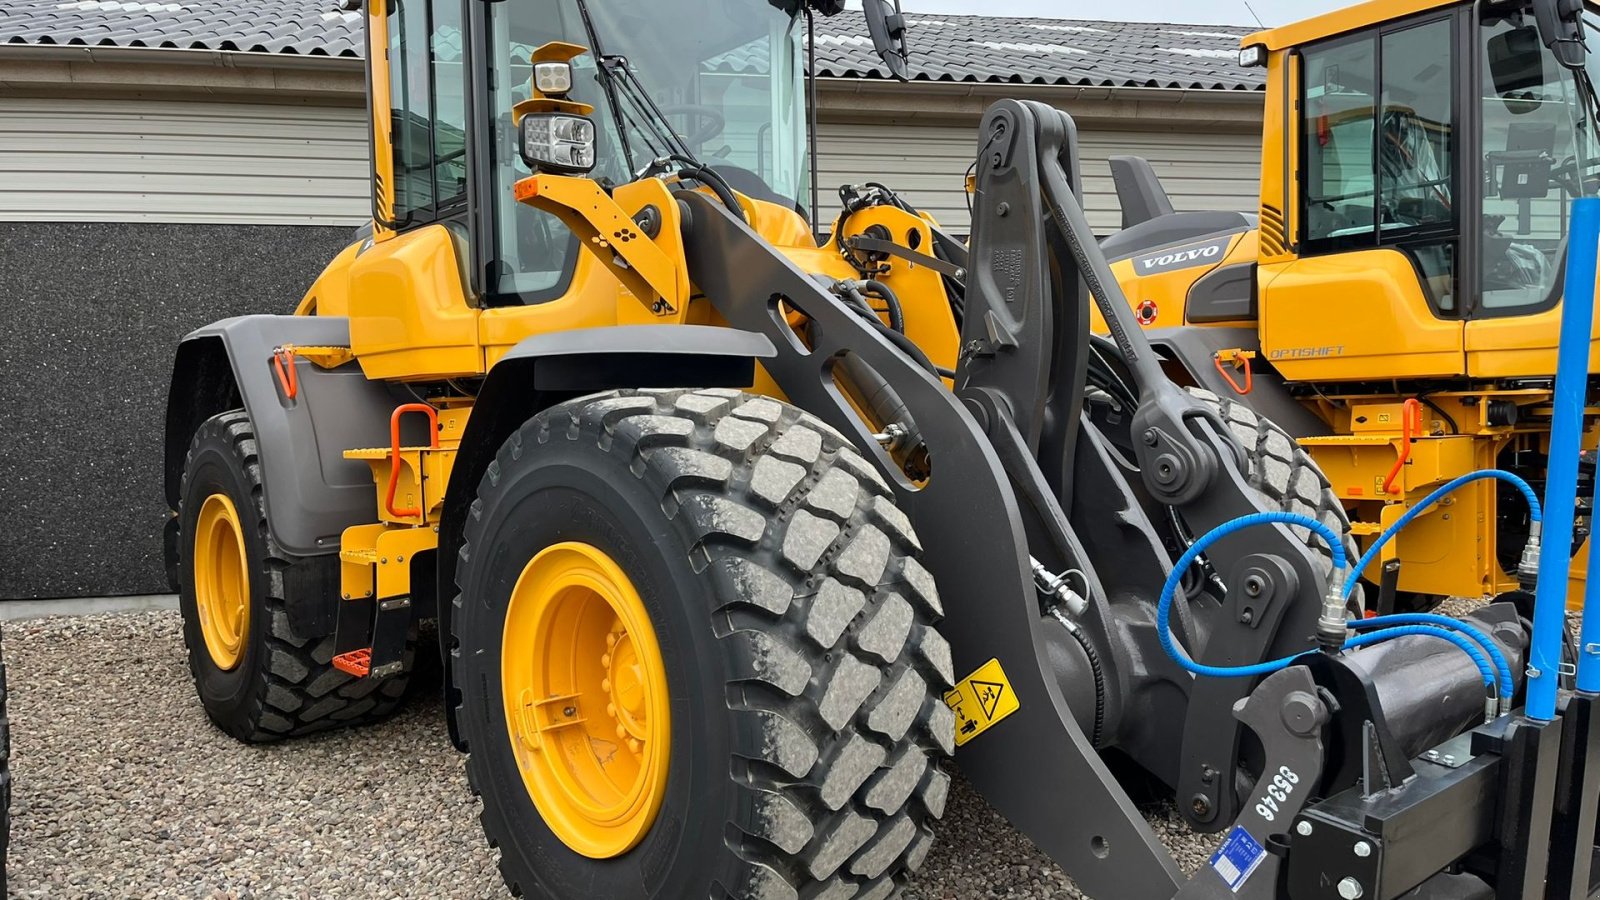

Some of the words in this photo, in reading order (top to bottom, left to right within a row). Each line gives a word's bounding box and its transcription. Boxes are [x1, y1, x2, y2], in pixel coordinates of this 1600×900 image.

[1143, 246, 1219, 268] VOLVO
[1270, 345, 1344, 359] OPTISHIFT
[1256, 766, 1299, 821] 85346
